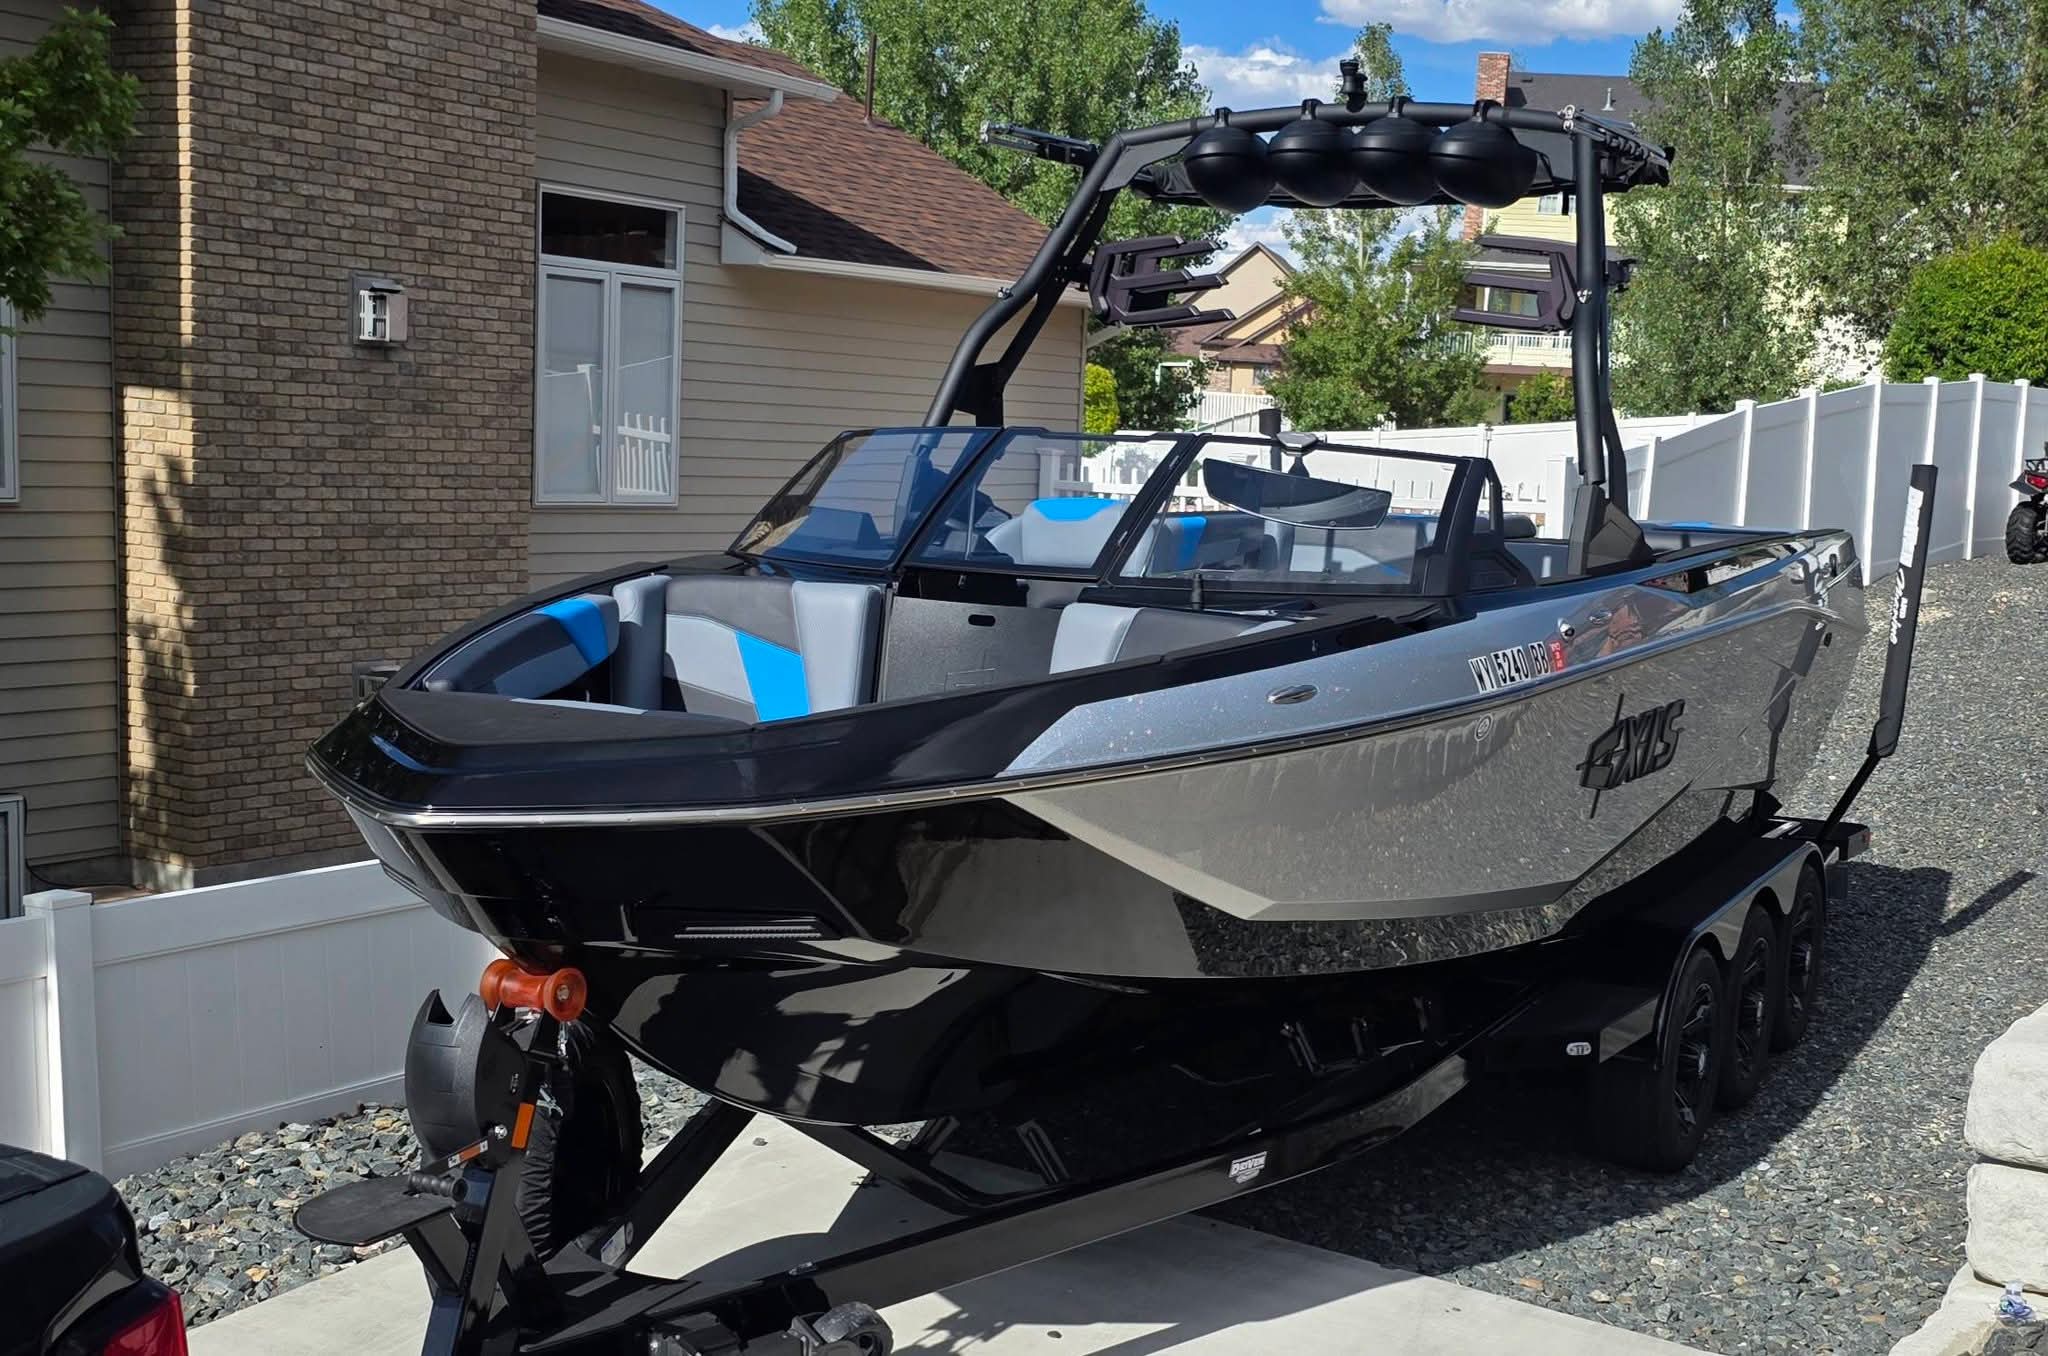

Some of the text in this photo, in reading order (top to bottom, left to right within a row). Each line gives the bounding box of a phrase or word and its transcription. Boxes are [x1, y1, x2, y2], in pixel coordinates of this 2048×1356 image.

[1470, 657, 1495, 692] WY
[1493, 648, 1530, 684] 5240
[1530, 643, 1549, 675] BB
[1577, 694, 1686, 800] AXIS
